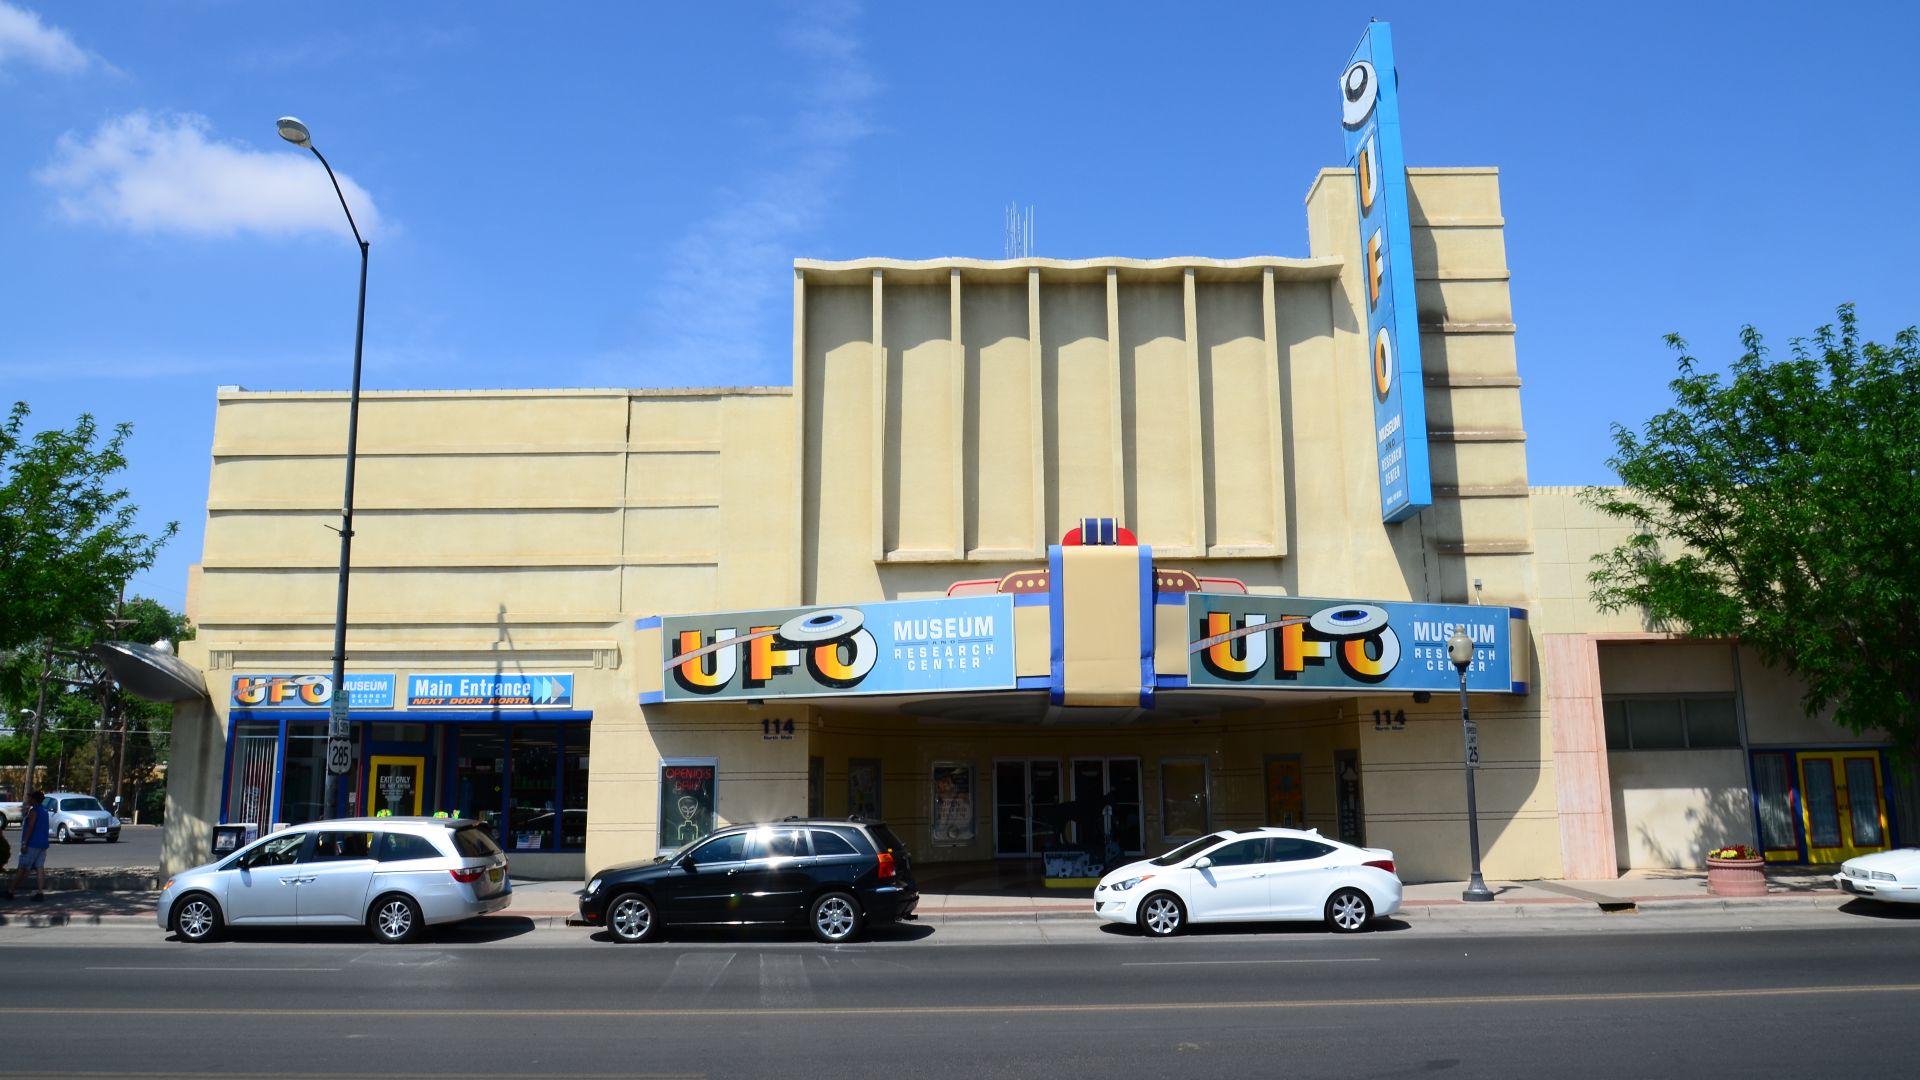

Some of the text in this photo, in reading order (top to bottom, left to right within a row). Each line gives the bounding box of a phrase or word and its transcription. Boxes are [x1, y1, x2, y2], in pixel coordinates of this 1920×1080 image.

[1358, 132, 1394, 400] UFO
[1379, 414, 1401, 443] MUSEUM
[1381, 447, 1402, 472] RESEARCH
[1385, 465, 1400, 486] CENTER
[893, 615, 994, 641] MUSEUM
[1413, 621, 1496, 644] MUSUM
[894, 643, 994, 660] RESEARCH
[1200, 611, 1401, 683] UFO
[1414, 647, 1496, 661] RESCH
[673, 626, 878, 692] UFO
[907, 656, 980, 671] CENTER
[1426, 660, 1486, 672] CENER
[235, 677, 333, 704] UFO
[343, 681, 388, 691] MUSEUM
[415, 679, 531, 697] Main Entrance
[412, 697, 530, 705] NEXT DOOR NORTH
[761, 718, 795, 735] 114
[1372, 709, 1406, 726] 114
[332, 745, 349, 766] 285
[1469, 746, 1479, 763] 25
